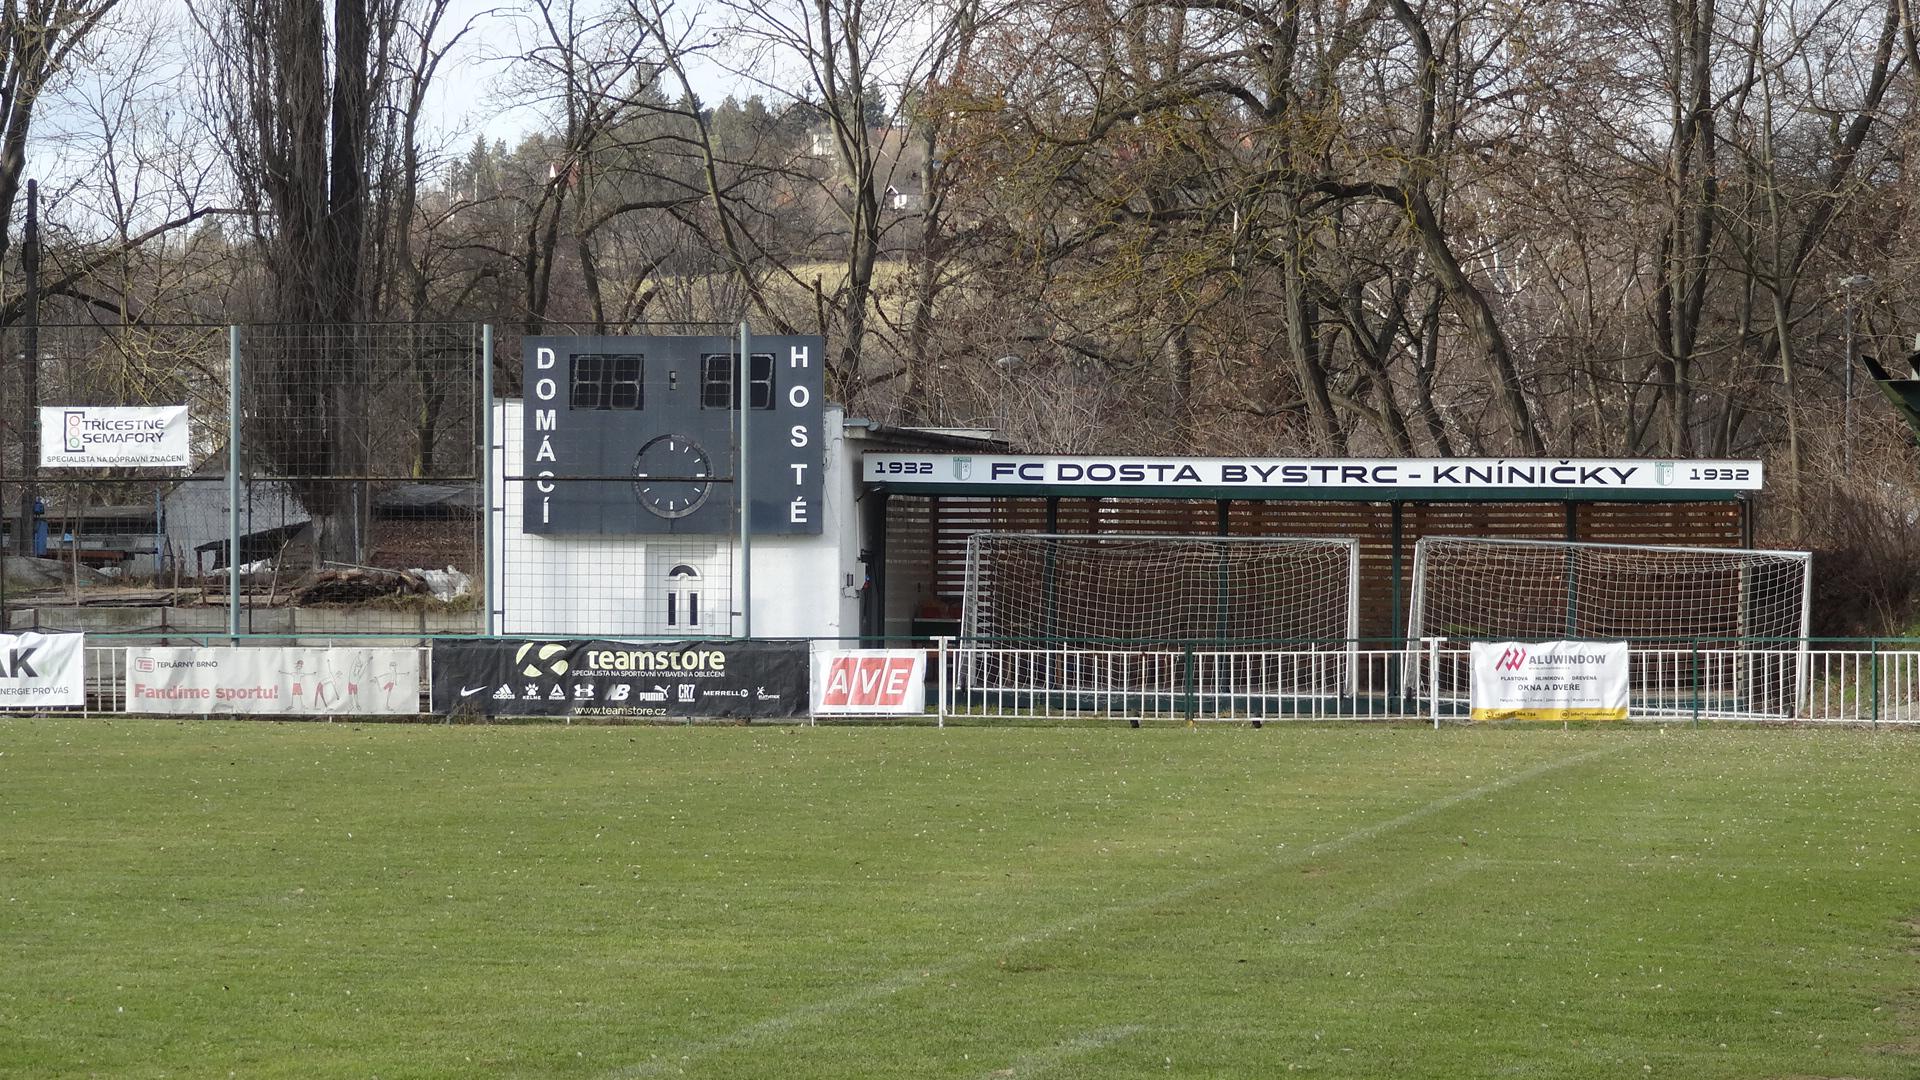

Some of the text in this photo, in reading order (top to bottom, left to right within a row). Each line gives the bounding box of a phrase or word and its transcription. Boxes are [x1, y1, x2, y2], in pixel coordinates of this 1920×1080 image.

[82, 417, 164, 431] TŘÍCESTNÉ
[82, 432, 165, 443] SEMAFORY
[535, 347, 557, 524] DOMÁCÍ
[788, 346, 810, 523] HOSTÉ
[46, 455, 95, 463] SPECIALISTA
[875, 461, 933, 474] 1932
[991, 462, 1045, 481] FC
[1057, 463, 1202, 482] DOSTA
[1221, 464, 1398, 483] BYSTRC
[1433, 460, 1639, 485] KNÍNIČKY
[1689, 468, 1750, 481] 1932
[157, 660, 194, 668] TEPLÁRNY
[587, 650, 726, 670] teamstore
[1528, 654, 1606, 665] ALUWINDOW
[620, 670, 656, 678] SPORTOVNÍ
[656, 670, 688, 678] VYBAVENÍ
[694, 670, 726, 678] OBLEČENÍ
[827, 668, 908, 694] AVE
[1552, 682, 1581, 691] DVEŘE
[0, 687, 31, 696] NERGIE
[32, 687, 51, 695] PRO
[134, 683, 279, 700] Fandíme sportu!
[678, 683, 696, 698] CR7
[574, 705, 667, 716] www.teamstore.cz
